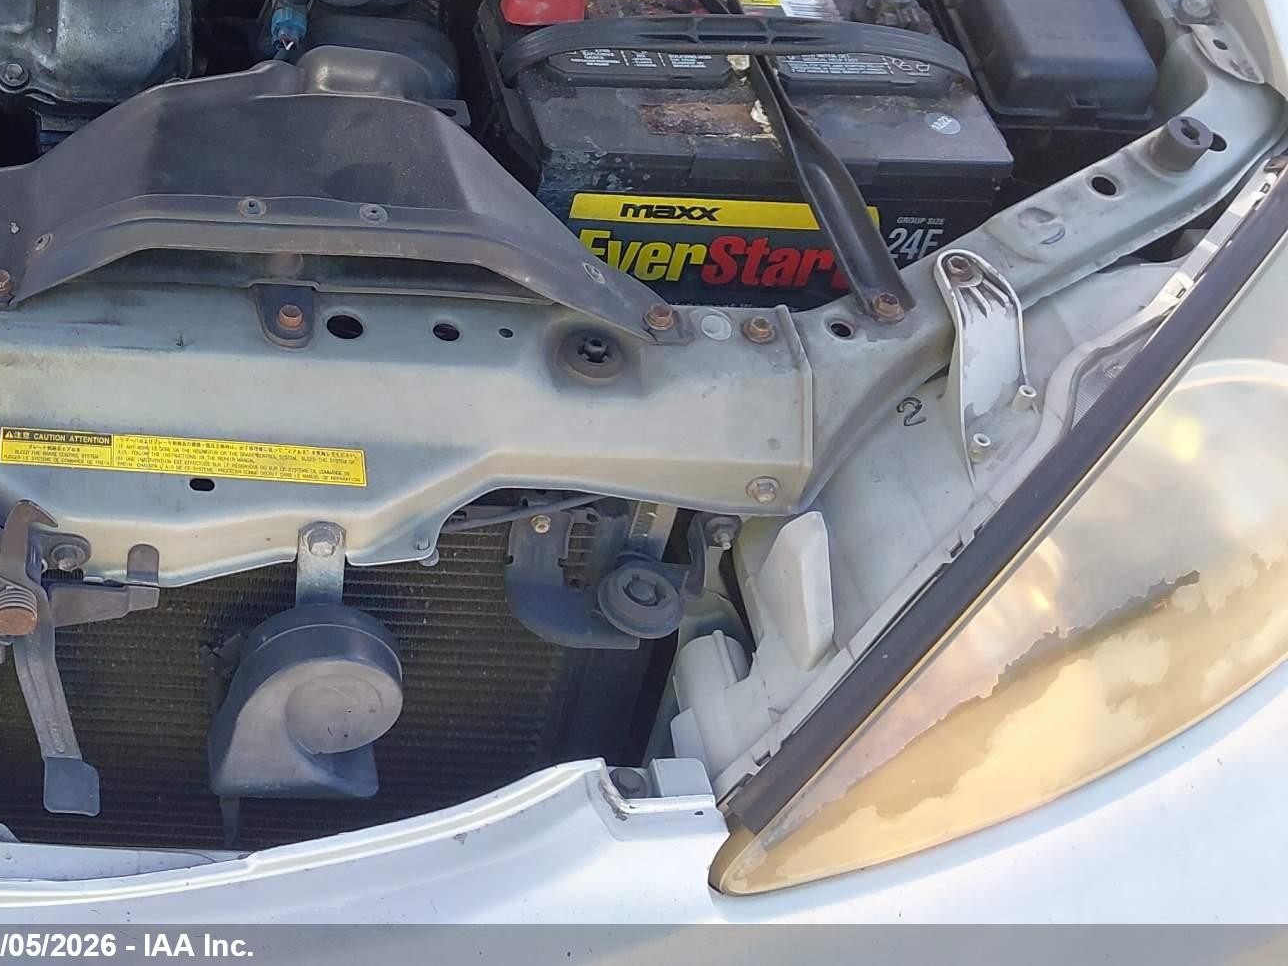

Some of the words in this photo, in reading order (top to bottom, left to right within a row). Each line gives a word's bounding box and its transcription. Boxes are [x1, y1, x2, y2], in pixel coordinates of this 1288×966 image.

[619, 203, 723, 222] maxx
[888, 227, 944, 260] 24F
[579, 229, 851, 291] EverStar
[896, 397, 927, 426] 2
[33, 433, 66, 442] CAUTION
[69, 435, 110, 445] ATTENTION
